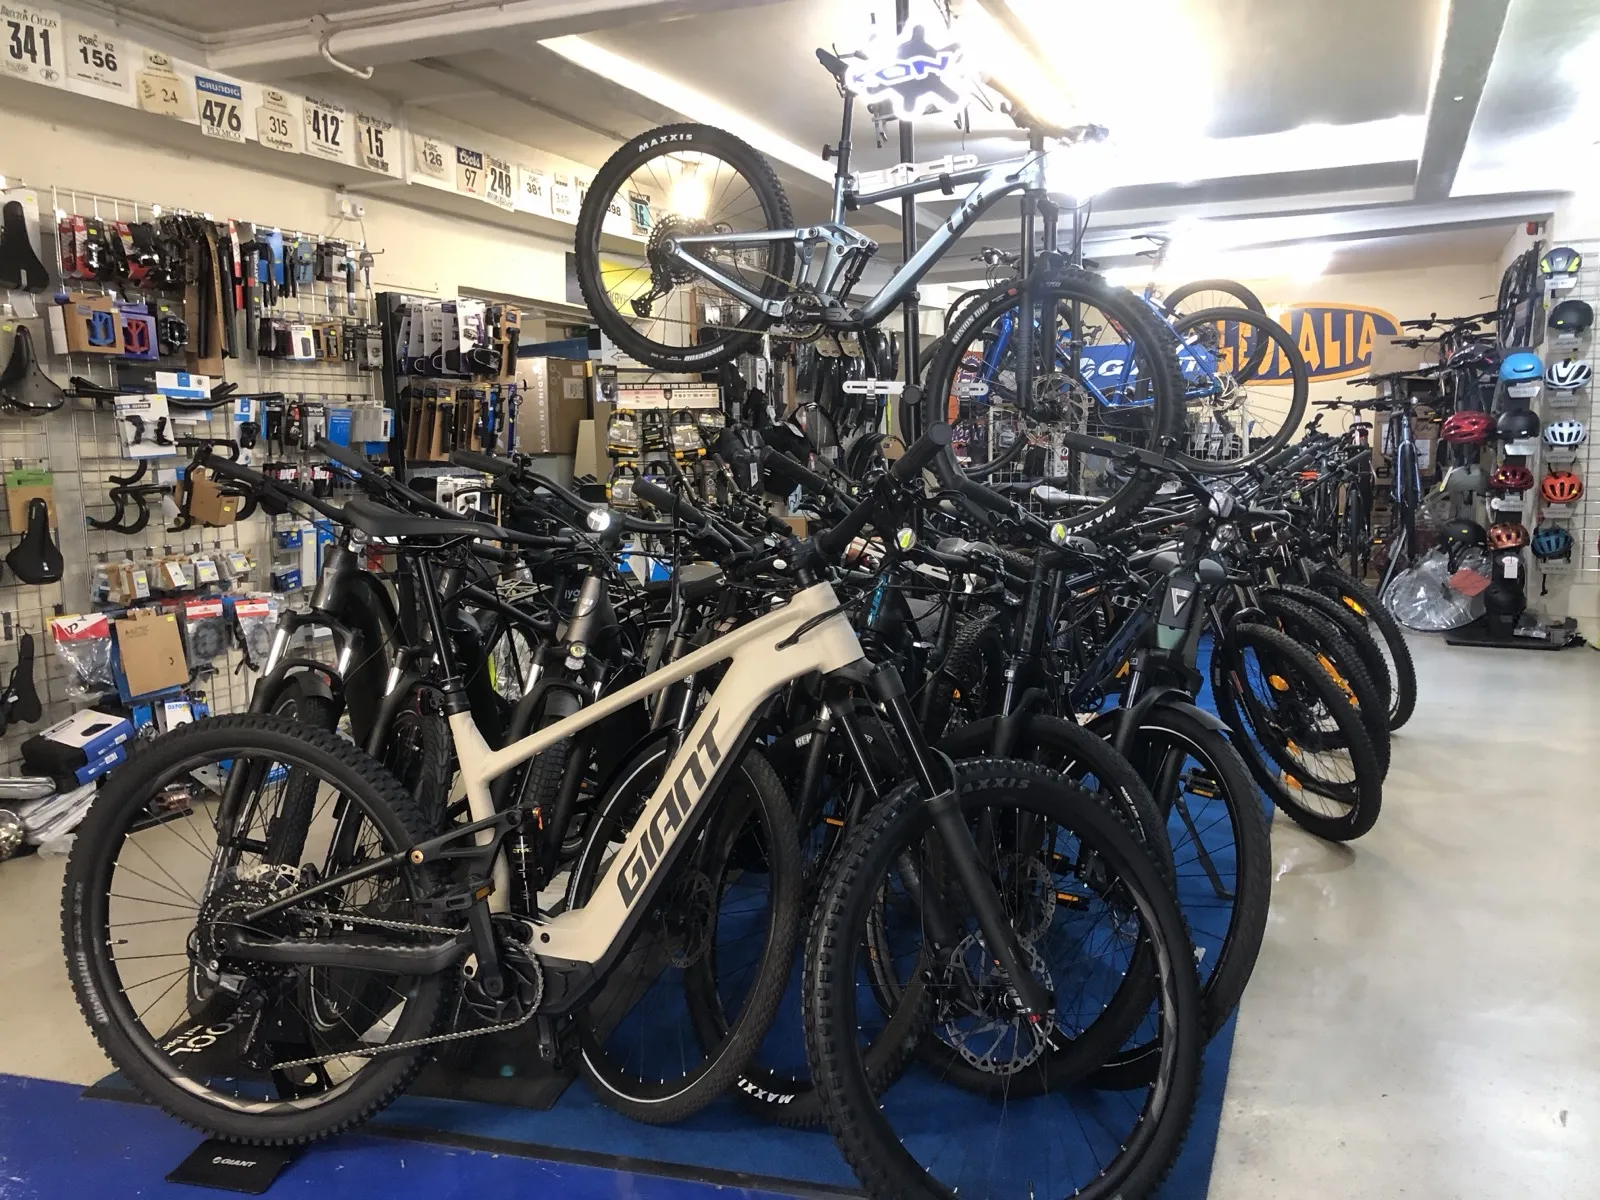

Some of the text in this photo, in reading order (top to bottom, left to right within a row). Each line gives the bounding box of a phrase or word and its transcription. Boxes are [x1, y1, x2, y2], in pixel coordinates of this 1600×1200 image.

[7, 21, 51, 66] 341
[79, 46, 118, 72] 156
[199, 80, 241, 96] GRUNDIG
[202, 99, 242, 132] 476
[269, 116, 288, 136] 315
[312, 109, 340, 147] 412
[366, 126, 384, 158] 15
[638, 134, 693, 153] MAXXIS
[422, 150, 442, 167] 126
[464, 168, 477, 188] 97
[490, 167, 512, 198] 248
[526, 182, 542, 197] 381
[1067, 505, 1117, 535] MAXXI
[962, 777, 1031, 794] AXXIS
[617, 706, 722, 910] GIANT
[737, 1074, 796, 1104] MAXXI
[220, 1158, 257, 1168] GIANT
